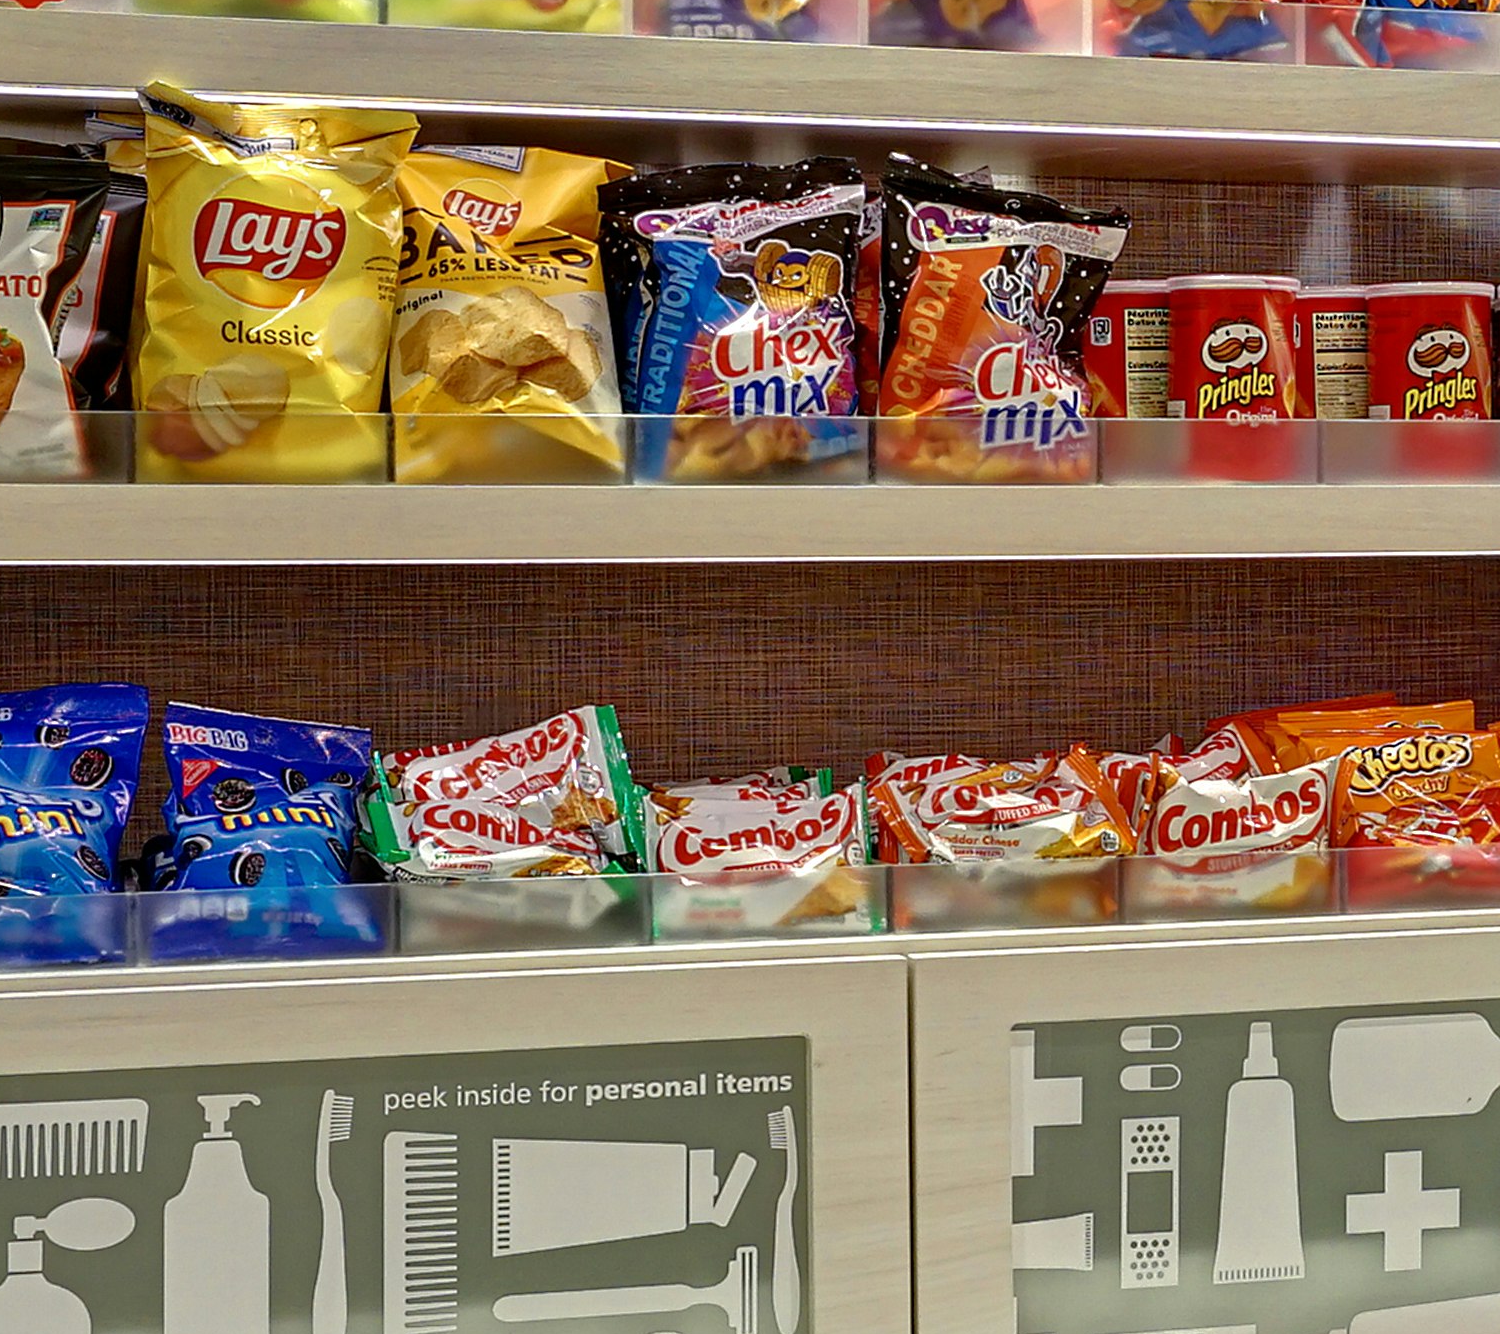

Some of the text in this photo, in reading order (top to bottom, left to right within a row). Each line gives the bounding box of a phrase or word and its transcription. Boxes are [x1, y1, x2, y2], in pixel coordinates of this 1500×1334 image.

[202, 197, 342, 281] Lay's
[448, 191, 519, 236] Lay's
[428, 258, 466, 278] 65%
[530, 264, 561, 281] FAT
[395, 290, 444, 316] original
[640, 240, 708, 415] TRADITIONAL
[891, 255, 963, 400] CHEDDAR
[220, 320, 317, 349] Classic
[715, 320, 840, 378] Chex
[733, 365, 838, 421] mix
[977, 343, 1075, 400] Chex
[1198, 367, 1276, 419] Pringles
[1404, 370, 1477, 419] Pringles
[983, 388, 1088, 447] mix
[167, 723, 249, 752] BIG BAG
[1347, 733, 1474, 796] Cheetos
[1157, 777, 1322, 852] Combos
[382, 1072, 793, 1115] peek inside for personal items
